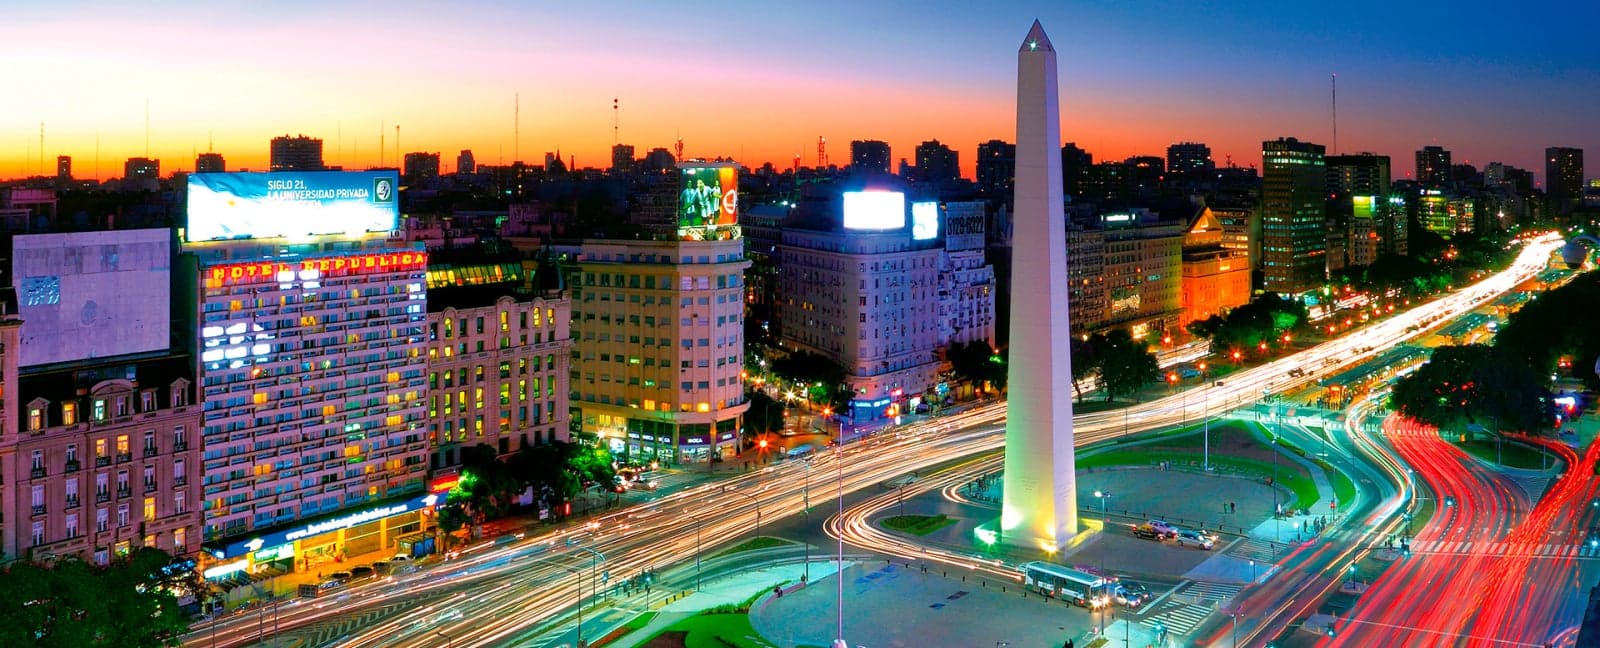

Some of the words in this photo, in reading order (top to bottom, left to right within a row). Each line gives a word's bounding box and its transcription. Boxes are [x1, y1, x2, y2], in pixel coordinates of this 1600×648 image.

[268, 180, 292, 190] SIGLO
[294, 180, 307, 191] 21,
[267, 190, 279, 200] LA
[281, 189, 335, 200] UNIVERSIDAD
[336, 188, 369, 198] PRIVADA
[212, 264, 289, 279] HOTEL
[304, 254, 424, 272] REPUBLICA
